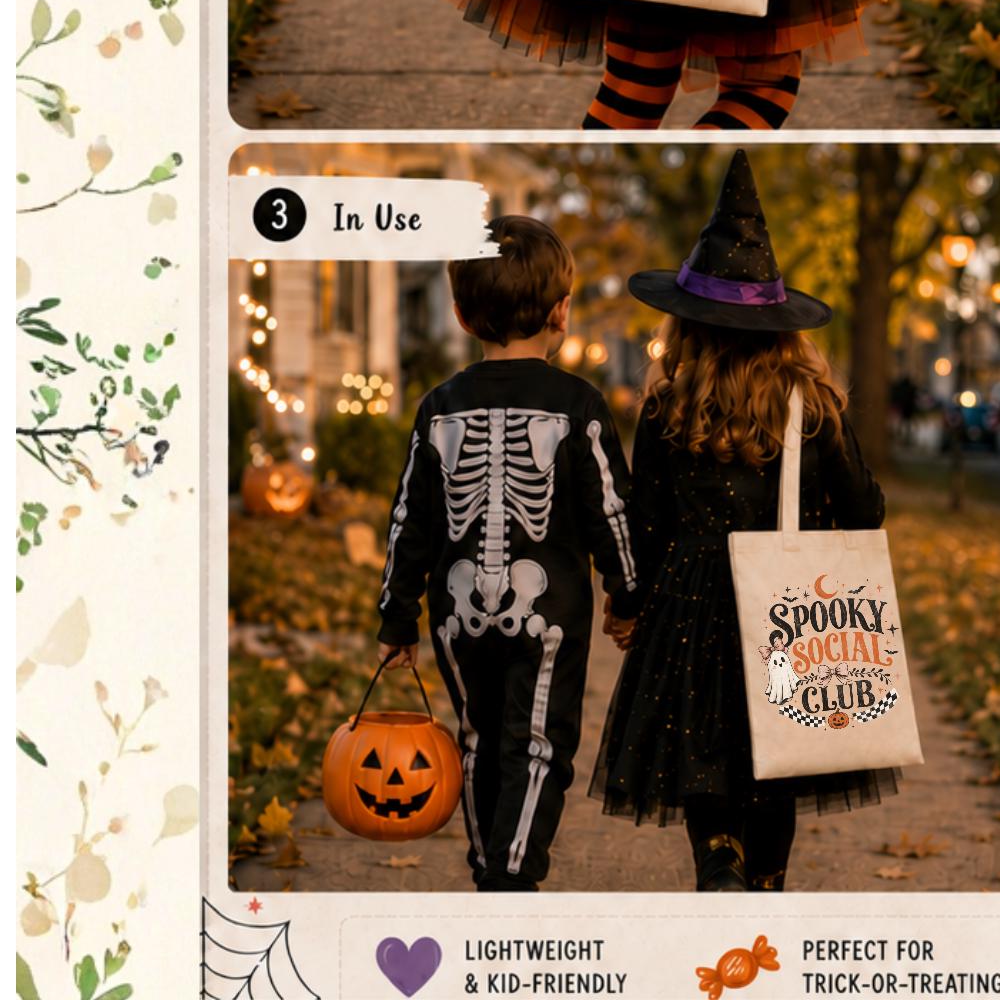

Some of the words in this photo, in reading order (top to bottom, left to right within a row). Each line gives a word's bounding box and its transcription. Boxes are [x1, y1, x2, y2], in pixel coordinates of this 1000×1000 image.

[768, 598, 888, 648] SPOOKY
[792, 631, 894, 674] SOCIAL
[801, 679, 876, 714] CLUB
